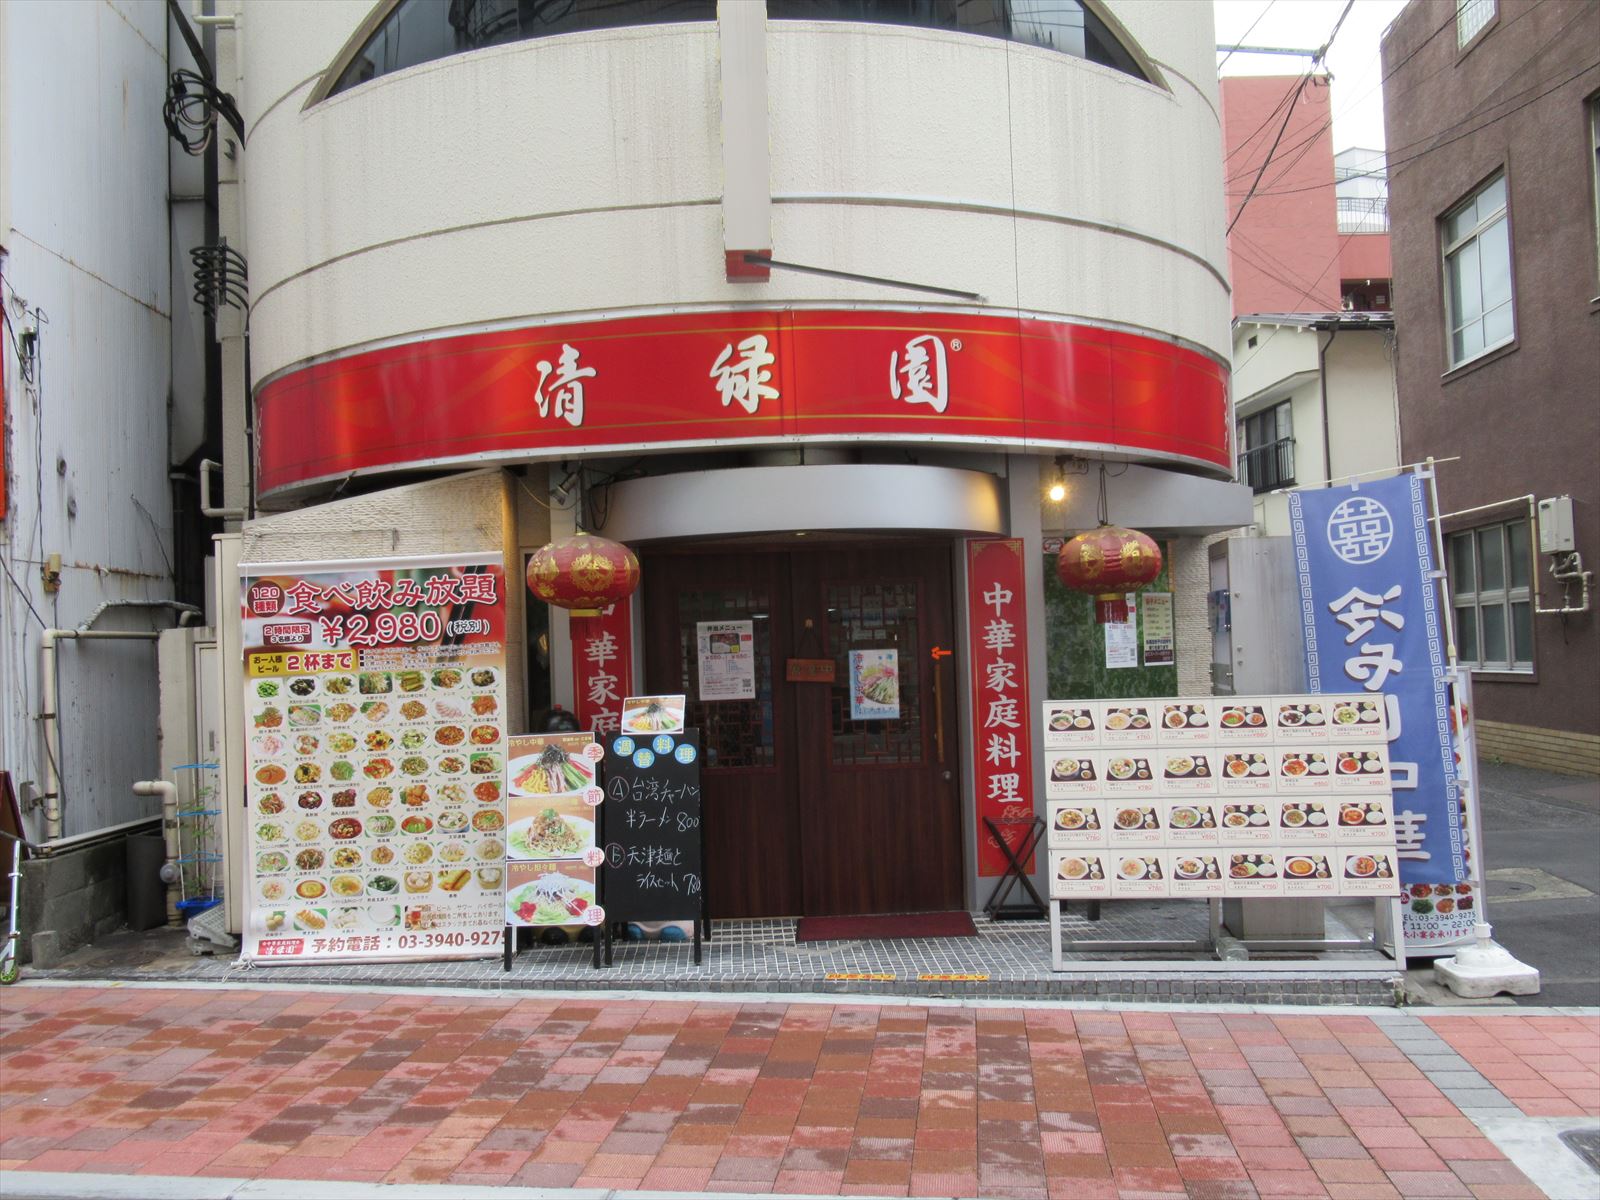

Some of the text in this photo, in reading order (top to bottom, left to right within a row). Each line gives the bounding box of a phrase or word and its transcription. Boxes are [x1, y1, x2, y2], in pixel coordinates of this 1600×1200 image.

[252, 586, 280, 600] 120
[287, 574, 497, 615] 食べ飲み放題
[254, 600, 278, 612] 種類
[264, 624, 310, 636] 2時間限定
[320, 611, 441, 646] ¥2,980
[253, 655, 283, 665] お一人様
[287, 652, 352, 671] 2杯まで
[257, 665, 280, 674] ビール
[981, 582, 1023, 802] 中華家庭料理
[1410, 922, 1439, 930] 11:00
